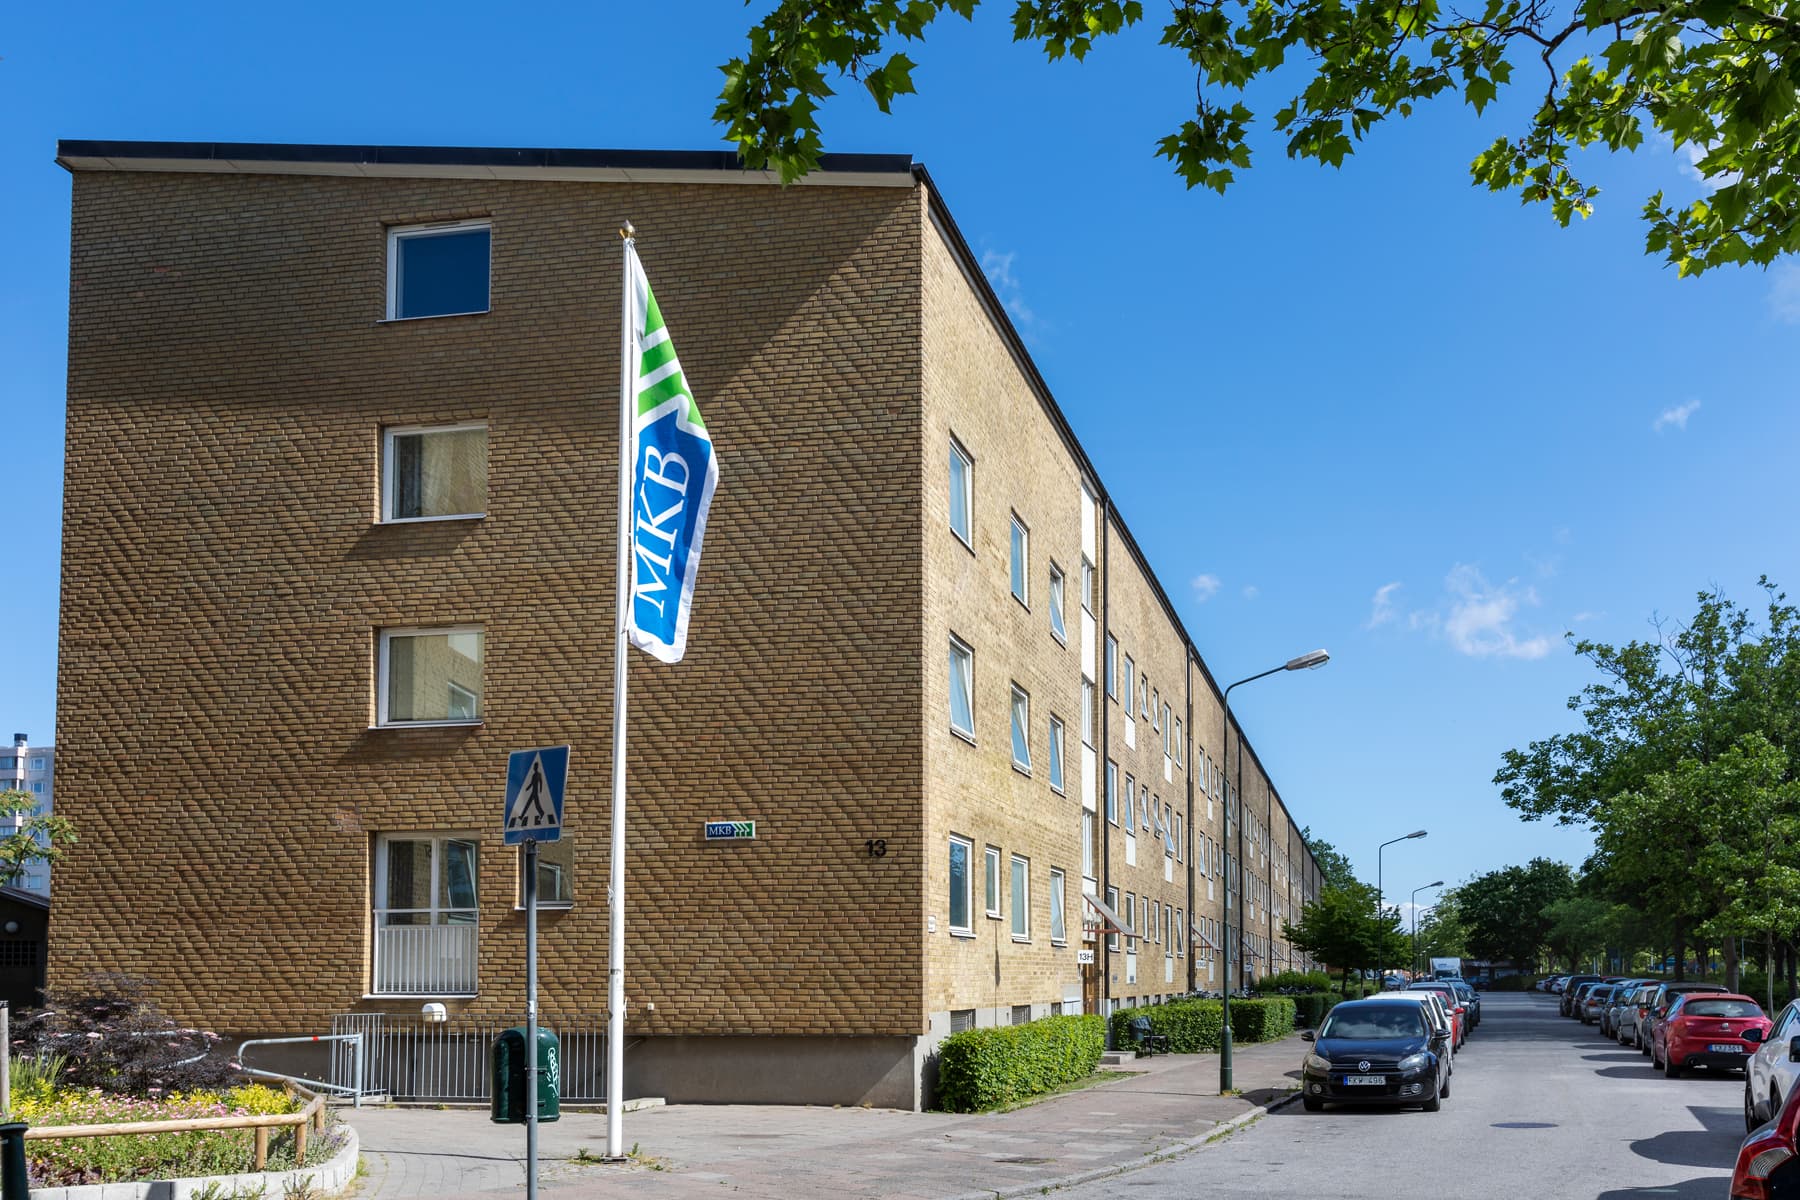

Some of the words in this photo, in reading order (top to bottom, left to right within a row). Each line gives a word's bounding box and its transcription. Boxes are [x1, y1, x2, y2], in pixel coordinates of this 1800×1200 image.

[635, 445, 690, 619] MKB
[708, 825, 732, 836] MKB
[865, 839, 887, 857] 13
[1079, 952, 1094, 961] 13H
